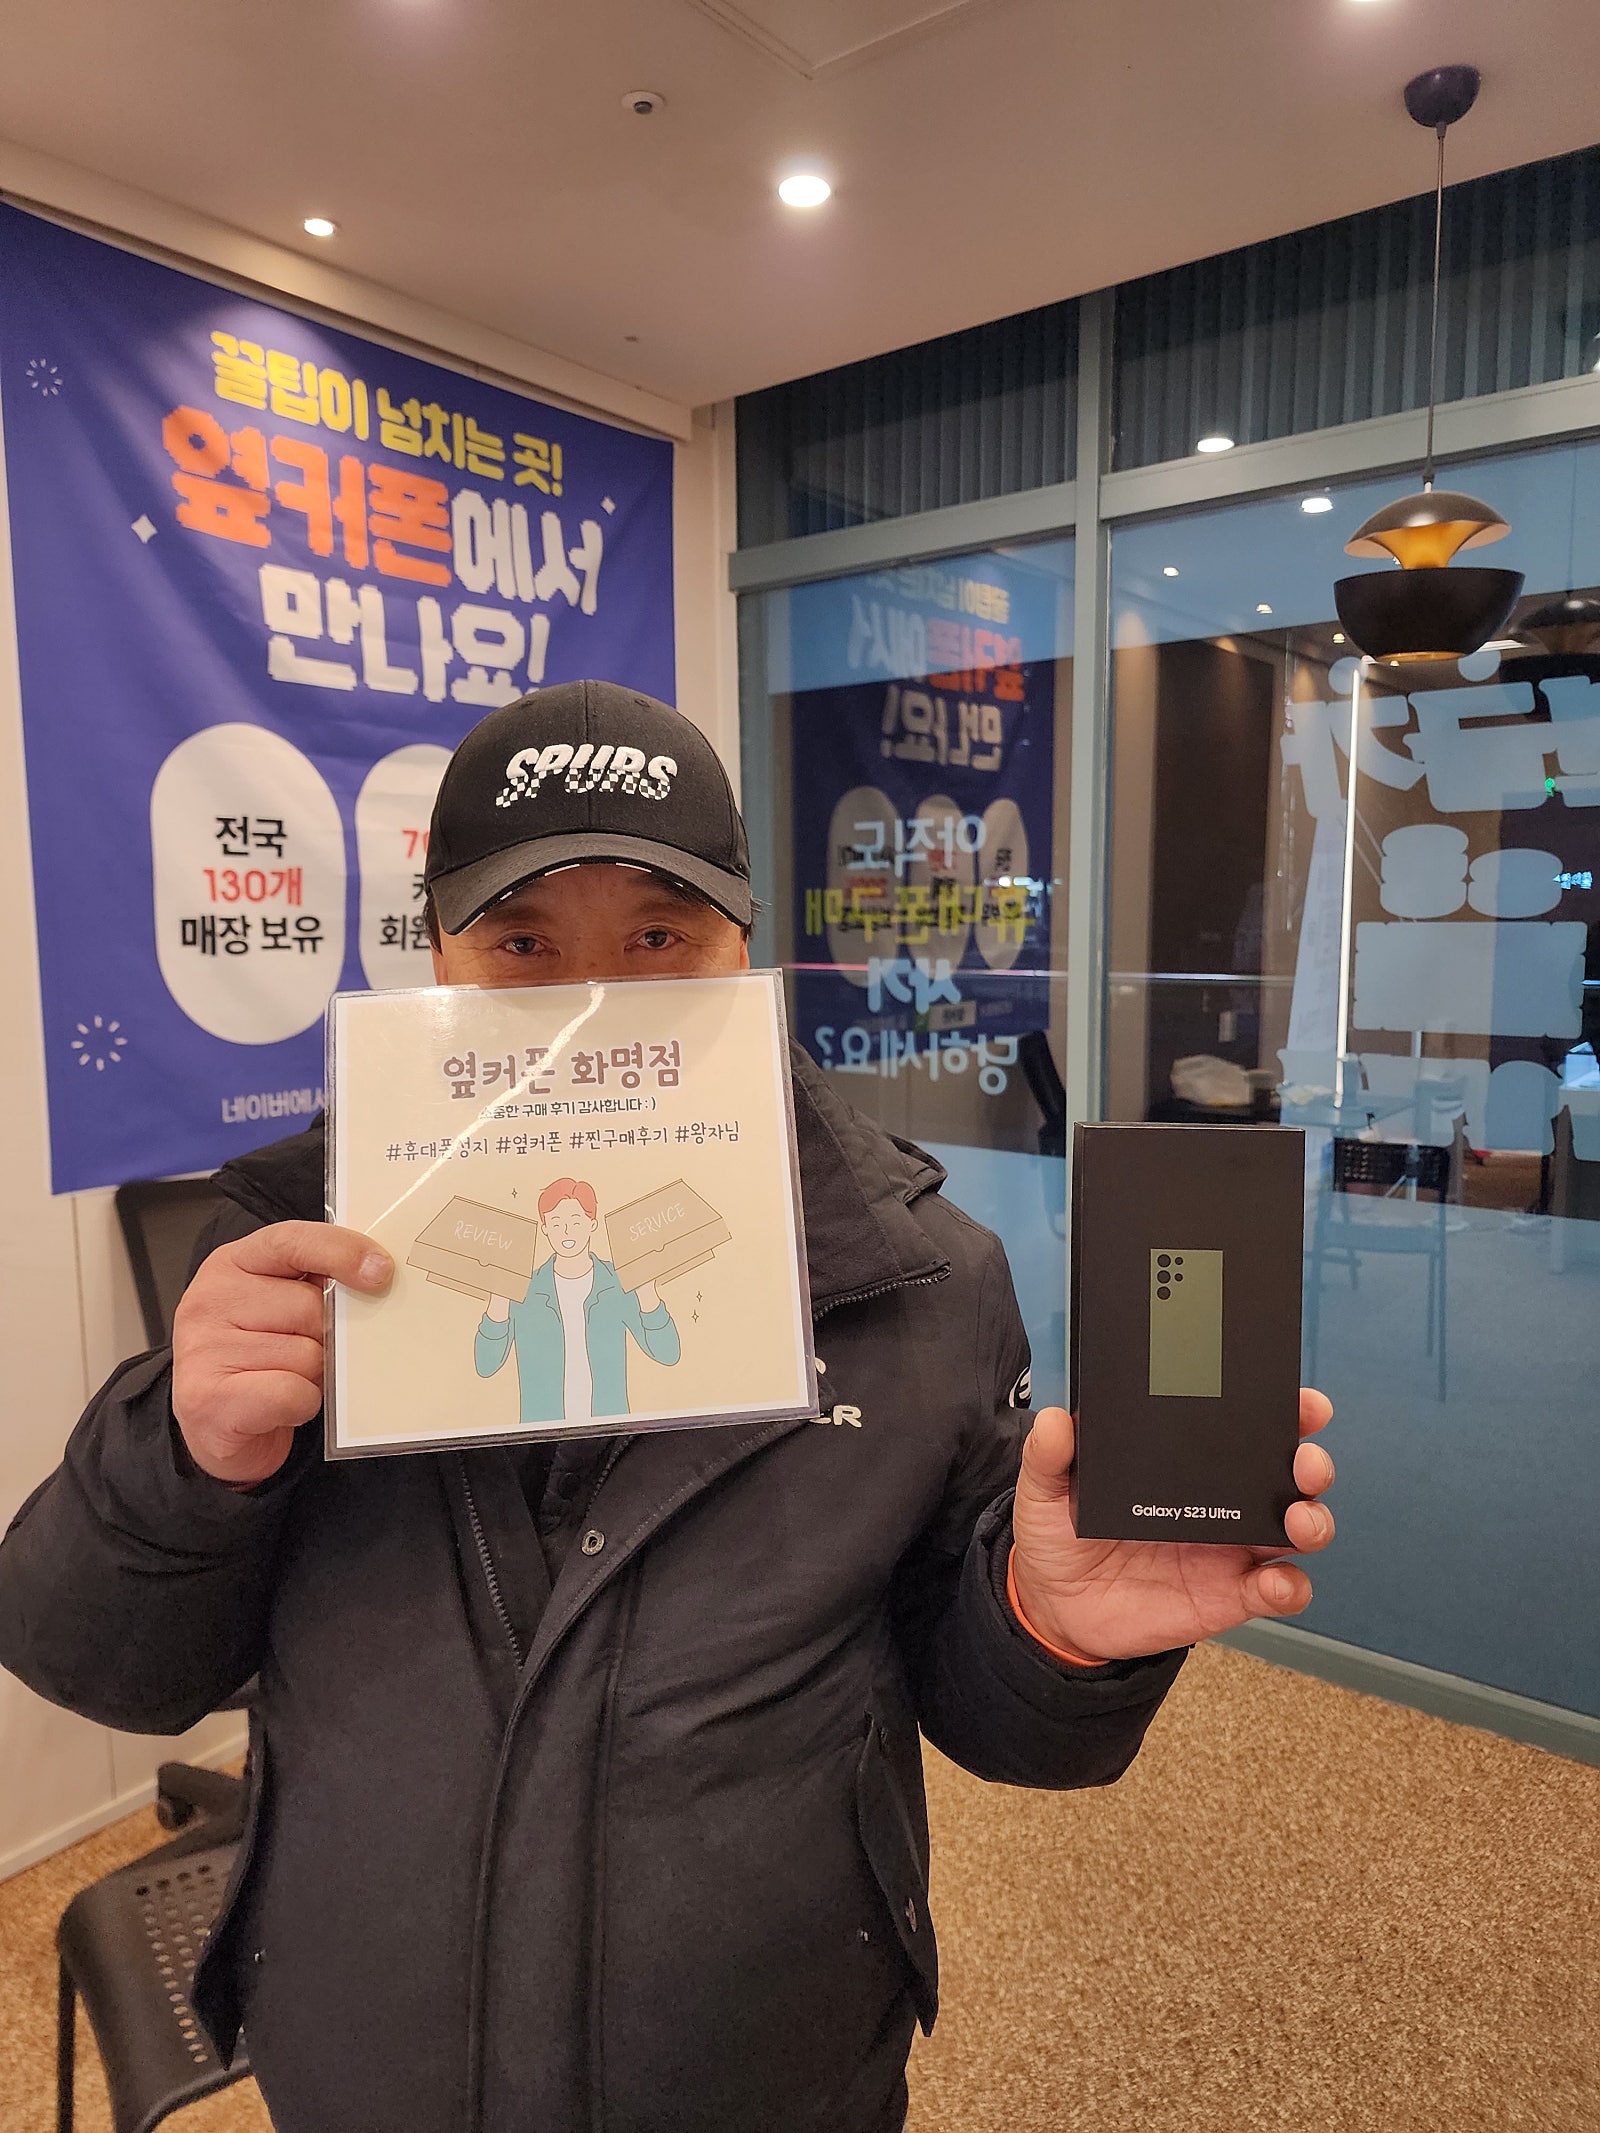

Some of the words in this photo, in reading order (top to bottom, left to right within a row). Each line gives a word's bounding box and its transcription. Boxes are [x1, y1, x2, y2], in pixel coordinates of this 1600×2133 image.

[211, 331, 370, 441] 꿀팁이
[377, 387, 505, 481] 넘치는
[512, 431, 563, 497] 곳!
[161, 404, 602, 616] 옆커폰에서
[258, 563, 550, 707] 만나요!
[496, 743, 678, 808] SPURS
[215, 815, 287, 858] 전국
[203, 867, 304, 907] 130개
[180, 915, 250, 957] 매장
[261, 915, 324, 955] 보유
[443, 1047, 556, 1100] 옆커폰
[571, 1040, 681, 1089] 화명점
[522, 1103, 548, 1118] 구매
[551, 1101, 576, 1116] 후기
[495, 1131, 563, 1156] #옆커폰
[569, 1125, 668, 1150] #찐구매후기
[674, 1120, 740, 1145] #왕자님
[454, 1219, 513, 1251] REVIEW
[628, 1203, 686, 1242] SERVICE
[1131, 1504, 1182, 1521] Galaxy
[1183, 1506, 1207, 1519] S23
[1208, 1507, 1241, 1520] Ultra
